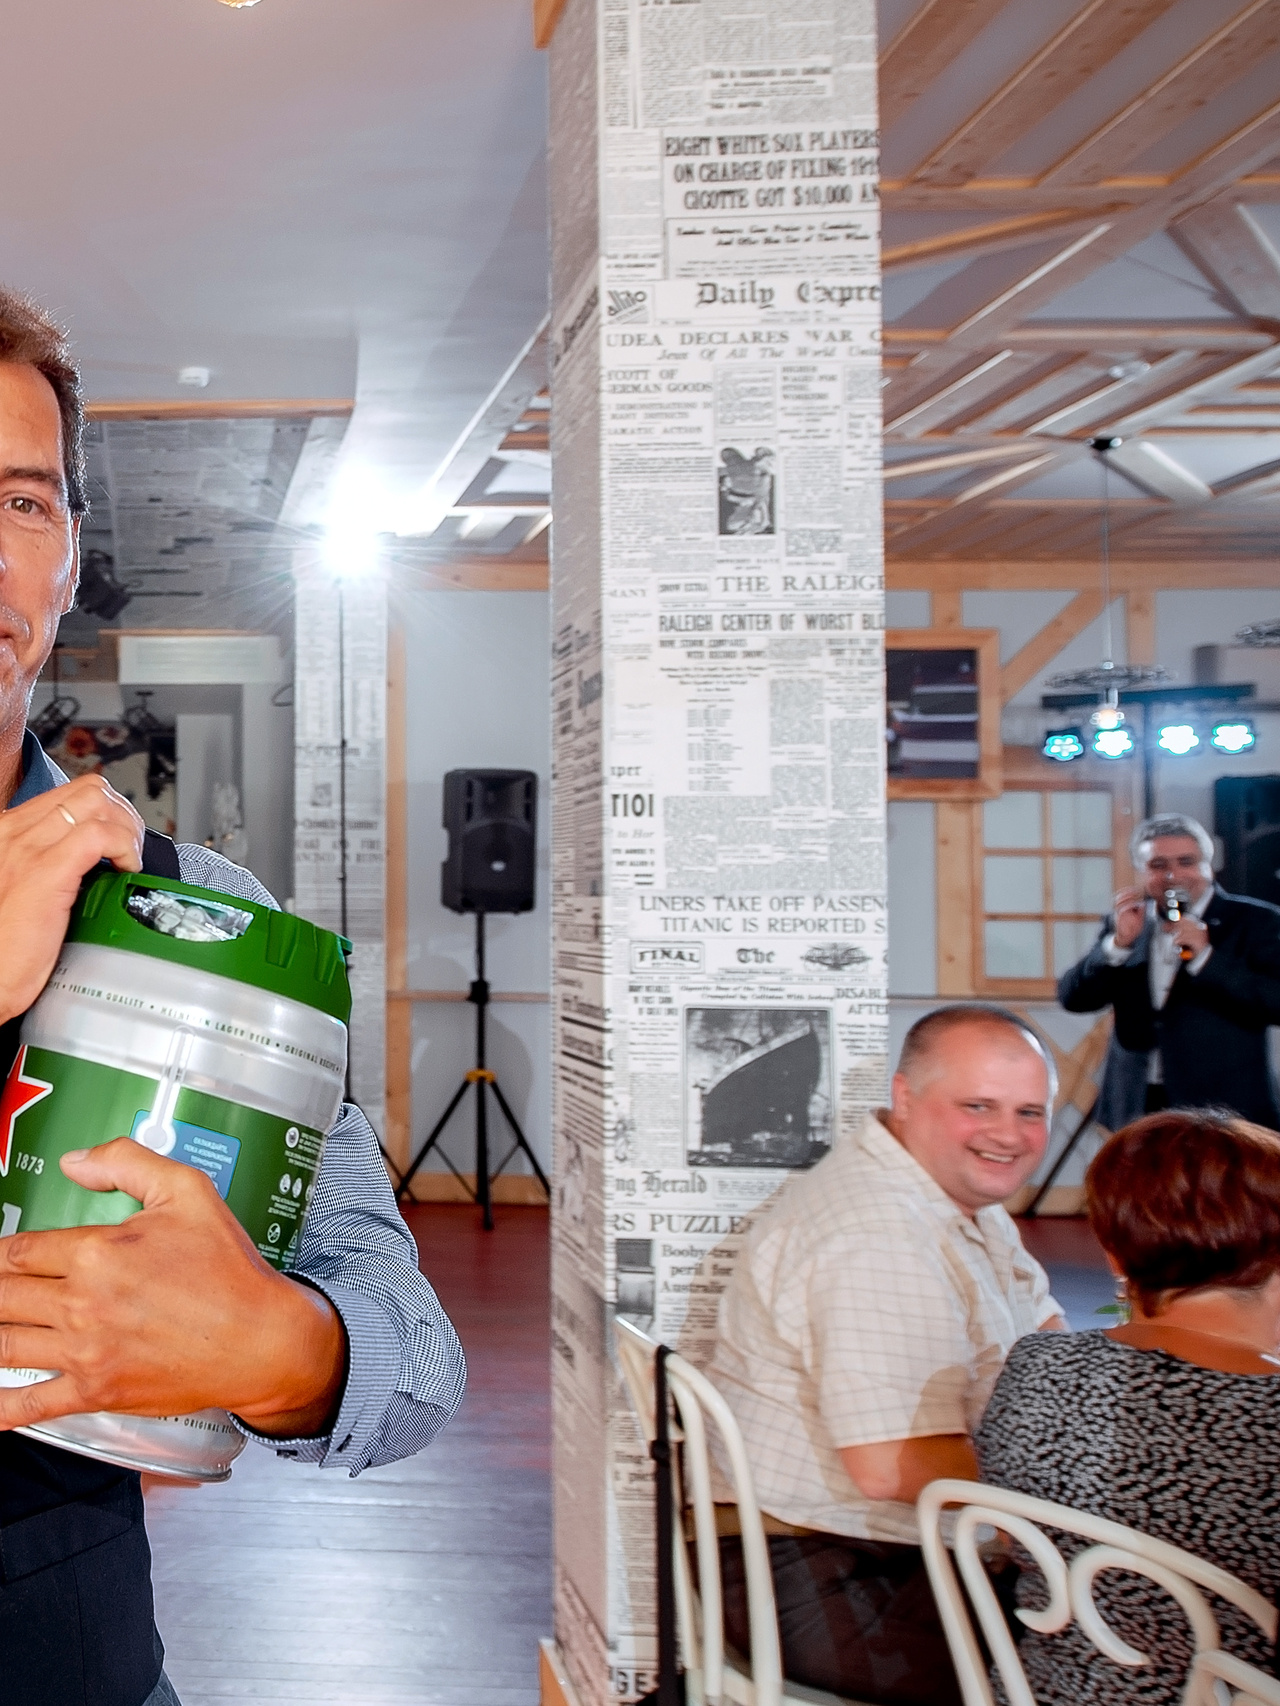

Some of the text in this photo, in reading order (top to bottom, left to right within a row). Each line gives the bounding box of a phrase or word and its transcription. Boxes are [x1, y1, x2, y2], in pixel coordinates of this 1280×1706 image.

[717, 134, 769, 155] WHITE
[773, 132, 802, 152] SOX
[674, 163, 695, 183] ON
[699, 161, 762, 182] CHARGE
[767, 159, 786, 179] OF
[755, 186, 785, 208] GOT
[696, 280, 775, 309] Daily
[680, 330, 790, 346] DECLARES
[805, 329, 853, 342] WAR
[760, 346, 784, 358] The
[659, 367, 679, 380] OF
[667, 382, 713, 394] GOODS
[718, 575, 770, 593] THE
[659, 614, 713, 633] RALEIGH
[721, 613, 772, 632] CENTER
[780, 613, 796, 631] OF
[804, 612, 855, 631] WORST
[640, 894, 887, 913] LINERS TAKE OFF PASSEN
[660, 917, 734, 933] TITANIC
[742, 917, 759, 933] IS
[767, 917, 866, 934] REPORTED
[639, 948, 700, 964] FINAL
[69, 984, 102, 998] PREMIUM
[106, 992, 145, 1009] QUALITY
[215, 1021, 245, 1037] LAGER
[284, 1044, 318, 1064] ORIGINAL
[15, 1151, 45, 1176] 1873
[641, 1170, 708, 1198] Herald
[670, 1263, 705, 1278] peril
[183, 1417, 220, 1433] ORIGINAL
